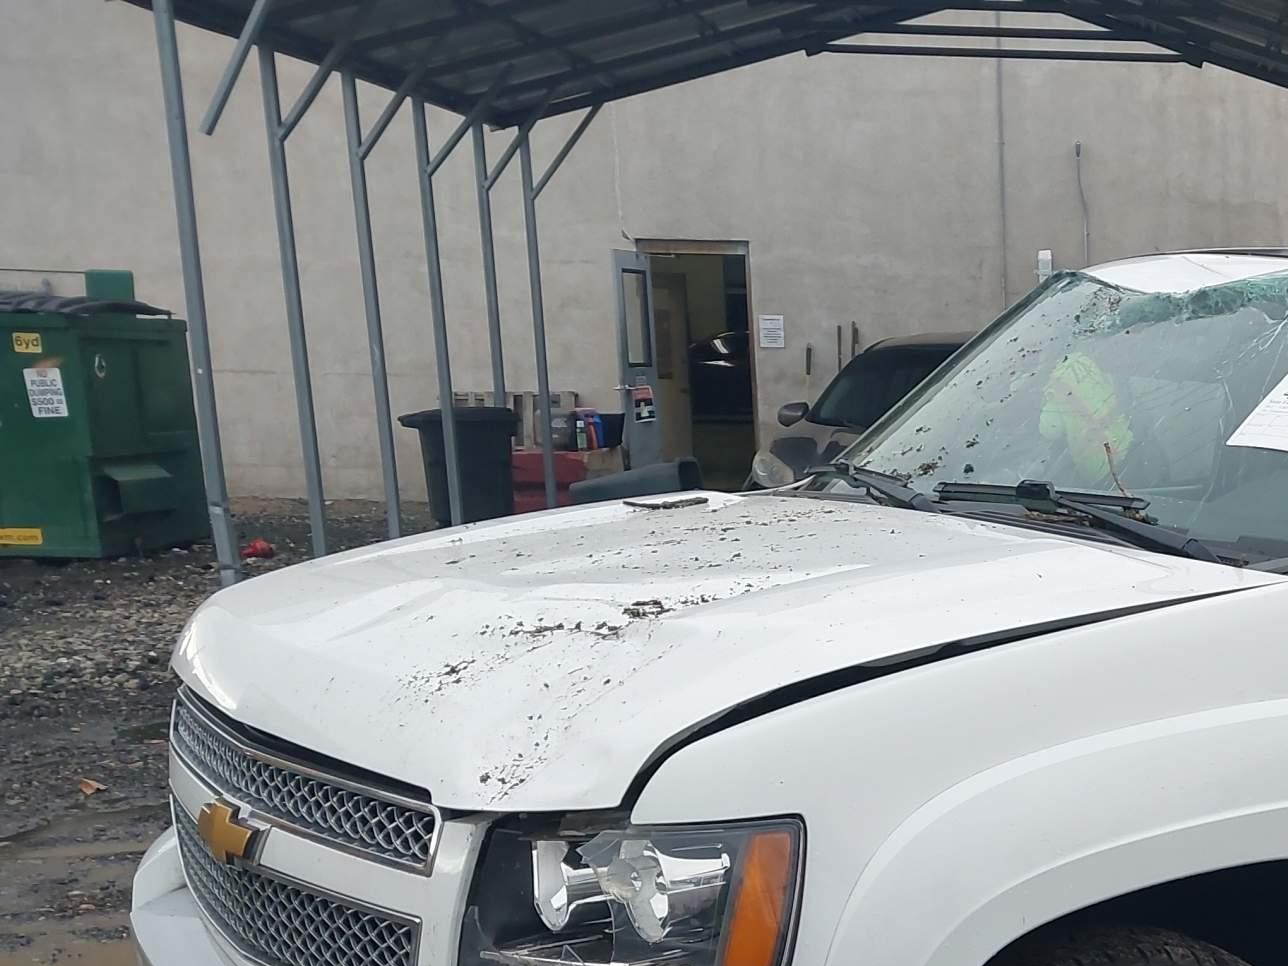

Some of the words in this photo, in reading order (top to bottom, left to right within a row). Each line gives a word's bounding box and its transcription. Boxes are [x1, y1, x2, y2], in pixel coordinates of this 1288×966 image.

[15, 335, 40, 349] 6yd
[30, 379, 57, 387] PUBLIC
[28, 388, 63, 397] DUMPING
[31, 397, 55, 406] $500
[38, 406, 62, 415] FINE
